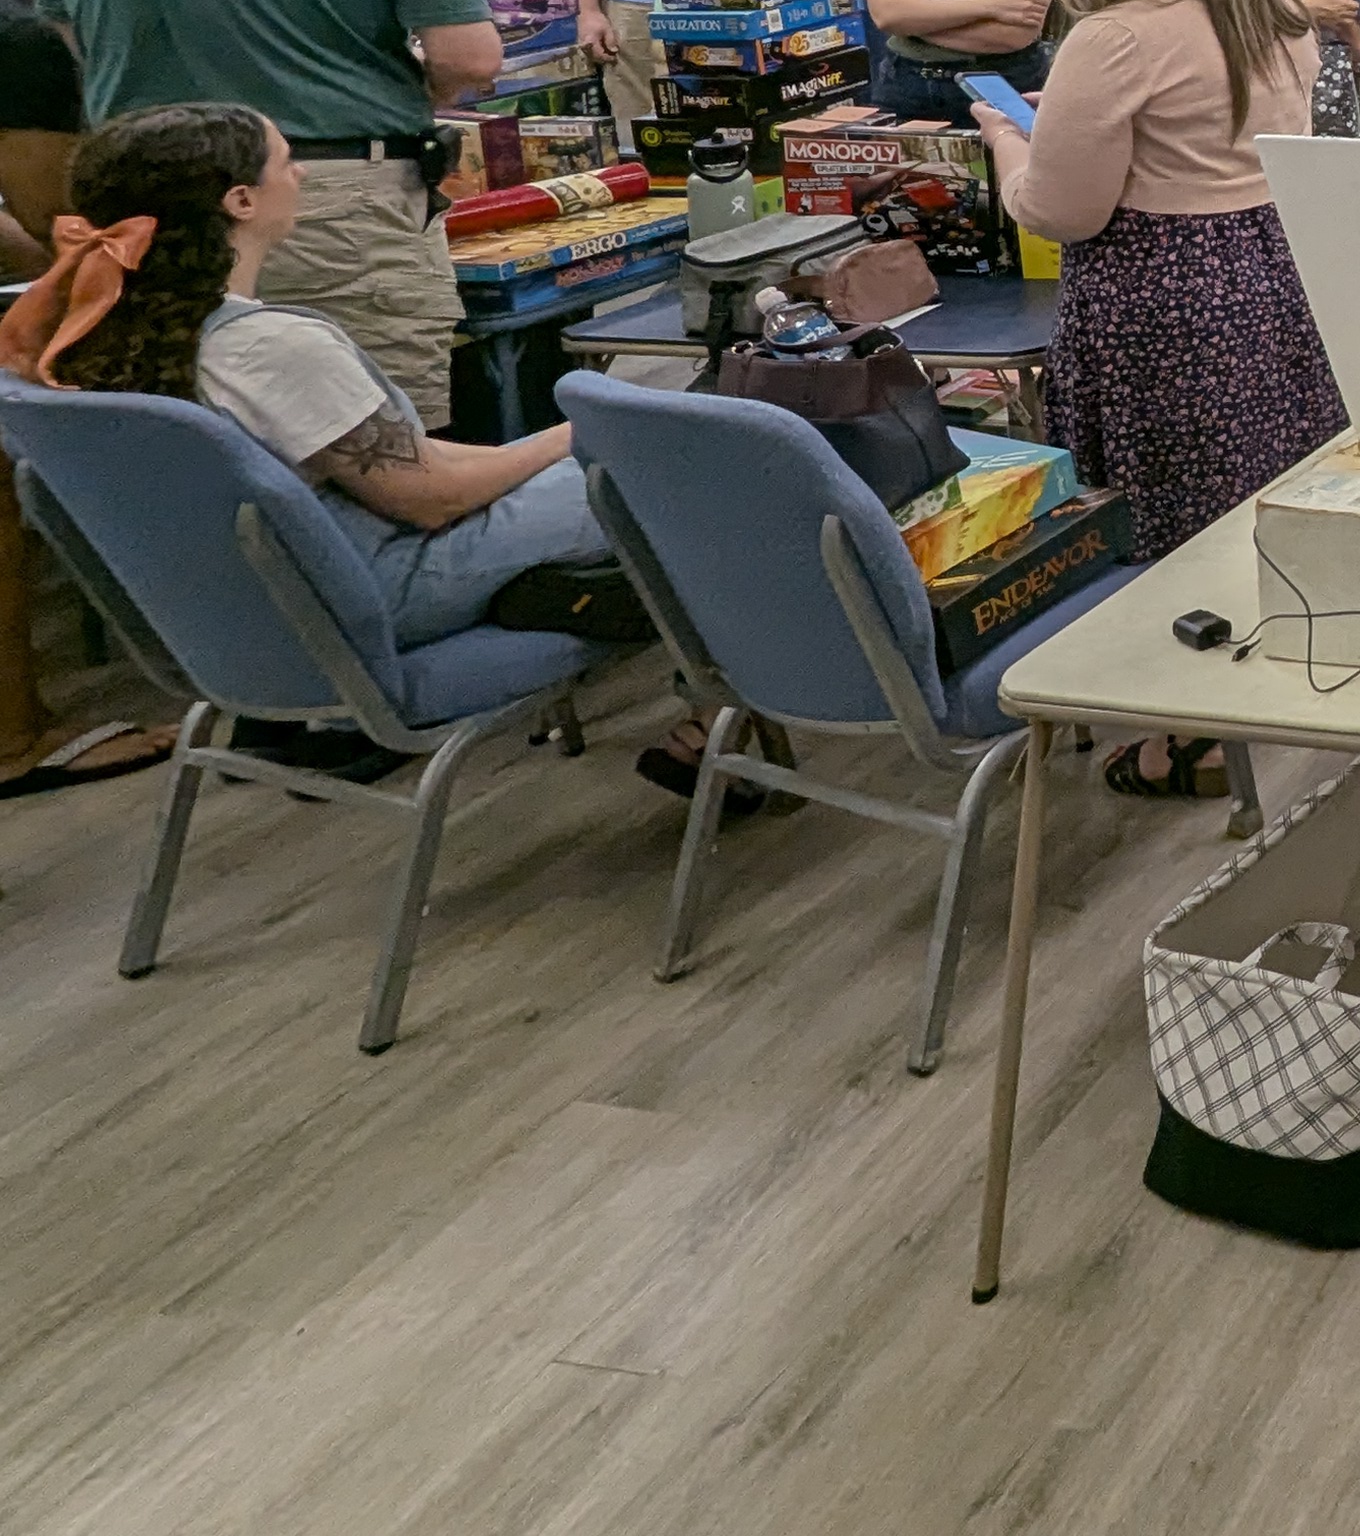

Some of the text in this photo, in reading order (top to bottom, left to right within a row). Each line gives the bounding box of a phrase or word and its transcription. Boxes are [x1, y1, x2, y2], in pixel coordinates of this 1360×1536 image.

[650, 19, 721, 31] CIVILIZATION
[789, 142, 896, 162] MONOPOLY
[569, 230, 628, 260] ERGO
[971, 529, 1109, 636] ENDEAVOR
